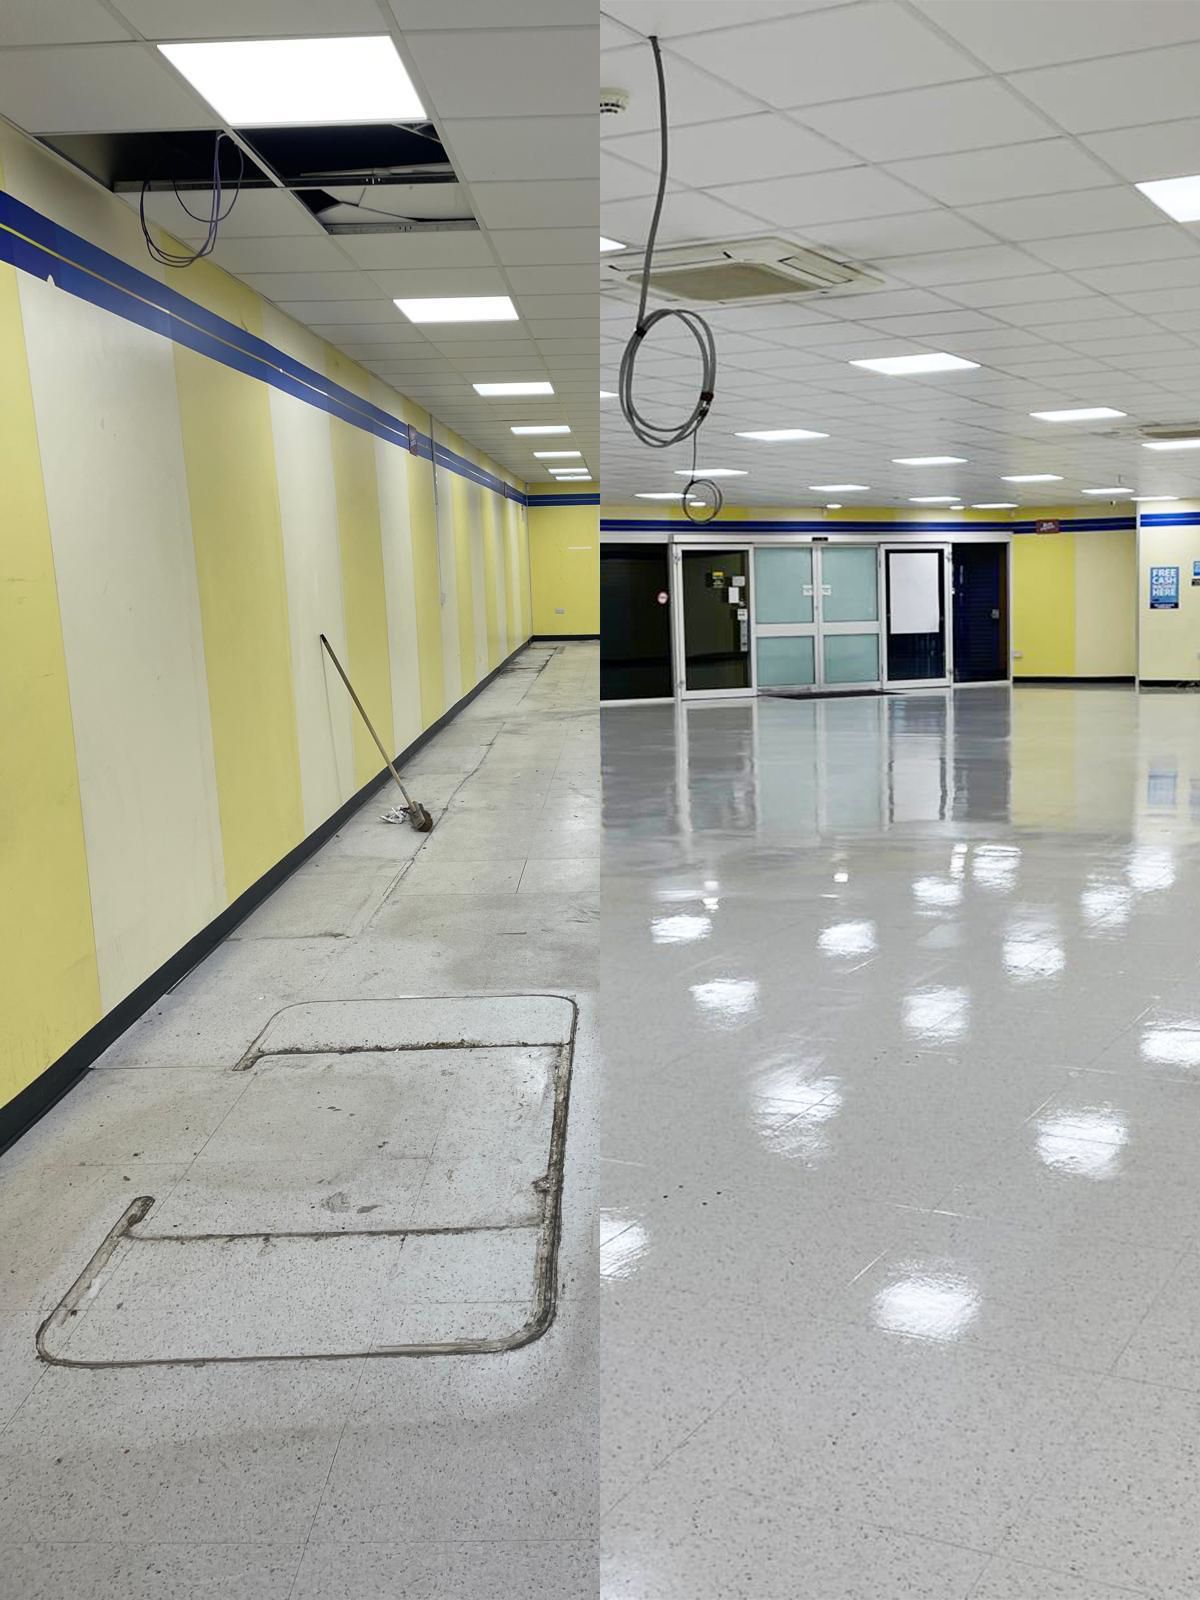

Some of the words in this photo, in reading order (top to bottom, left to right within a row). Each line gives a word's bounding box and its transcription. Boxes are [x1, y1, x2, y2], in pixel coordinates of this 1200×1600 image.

[1152, 568, 1177, 577] FREE
[1152, 576, 1177, 585] CASH
[1152, 588, 1176, 597] HERE
